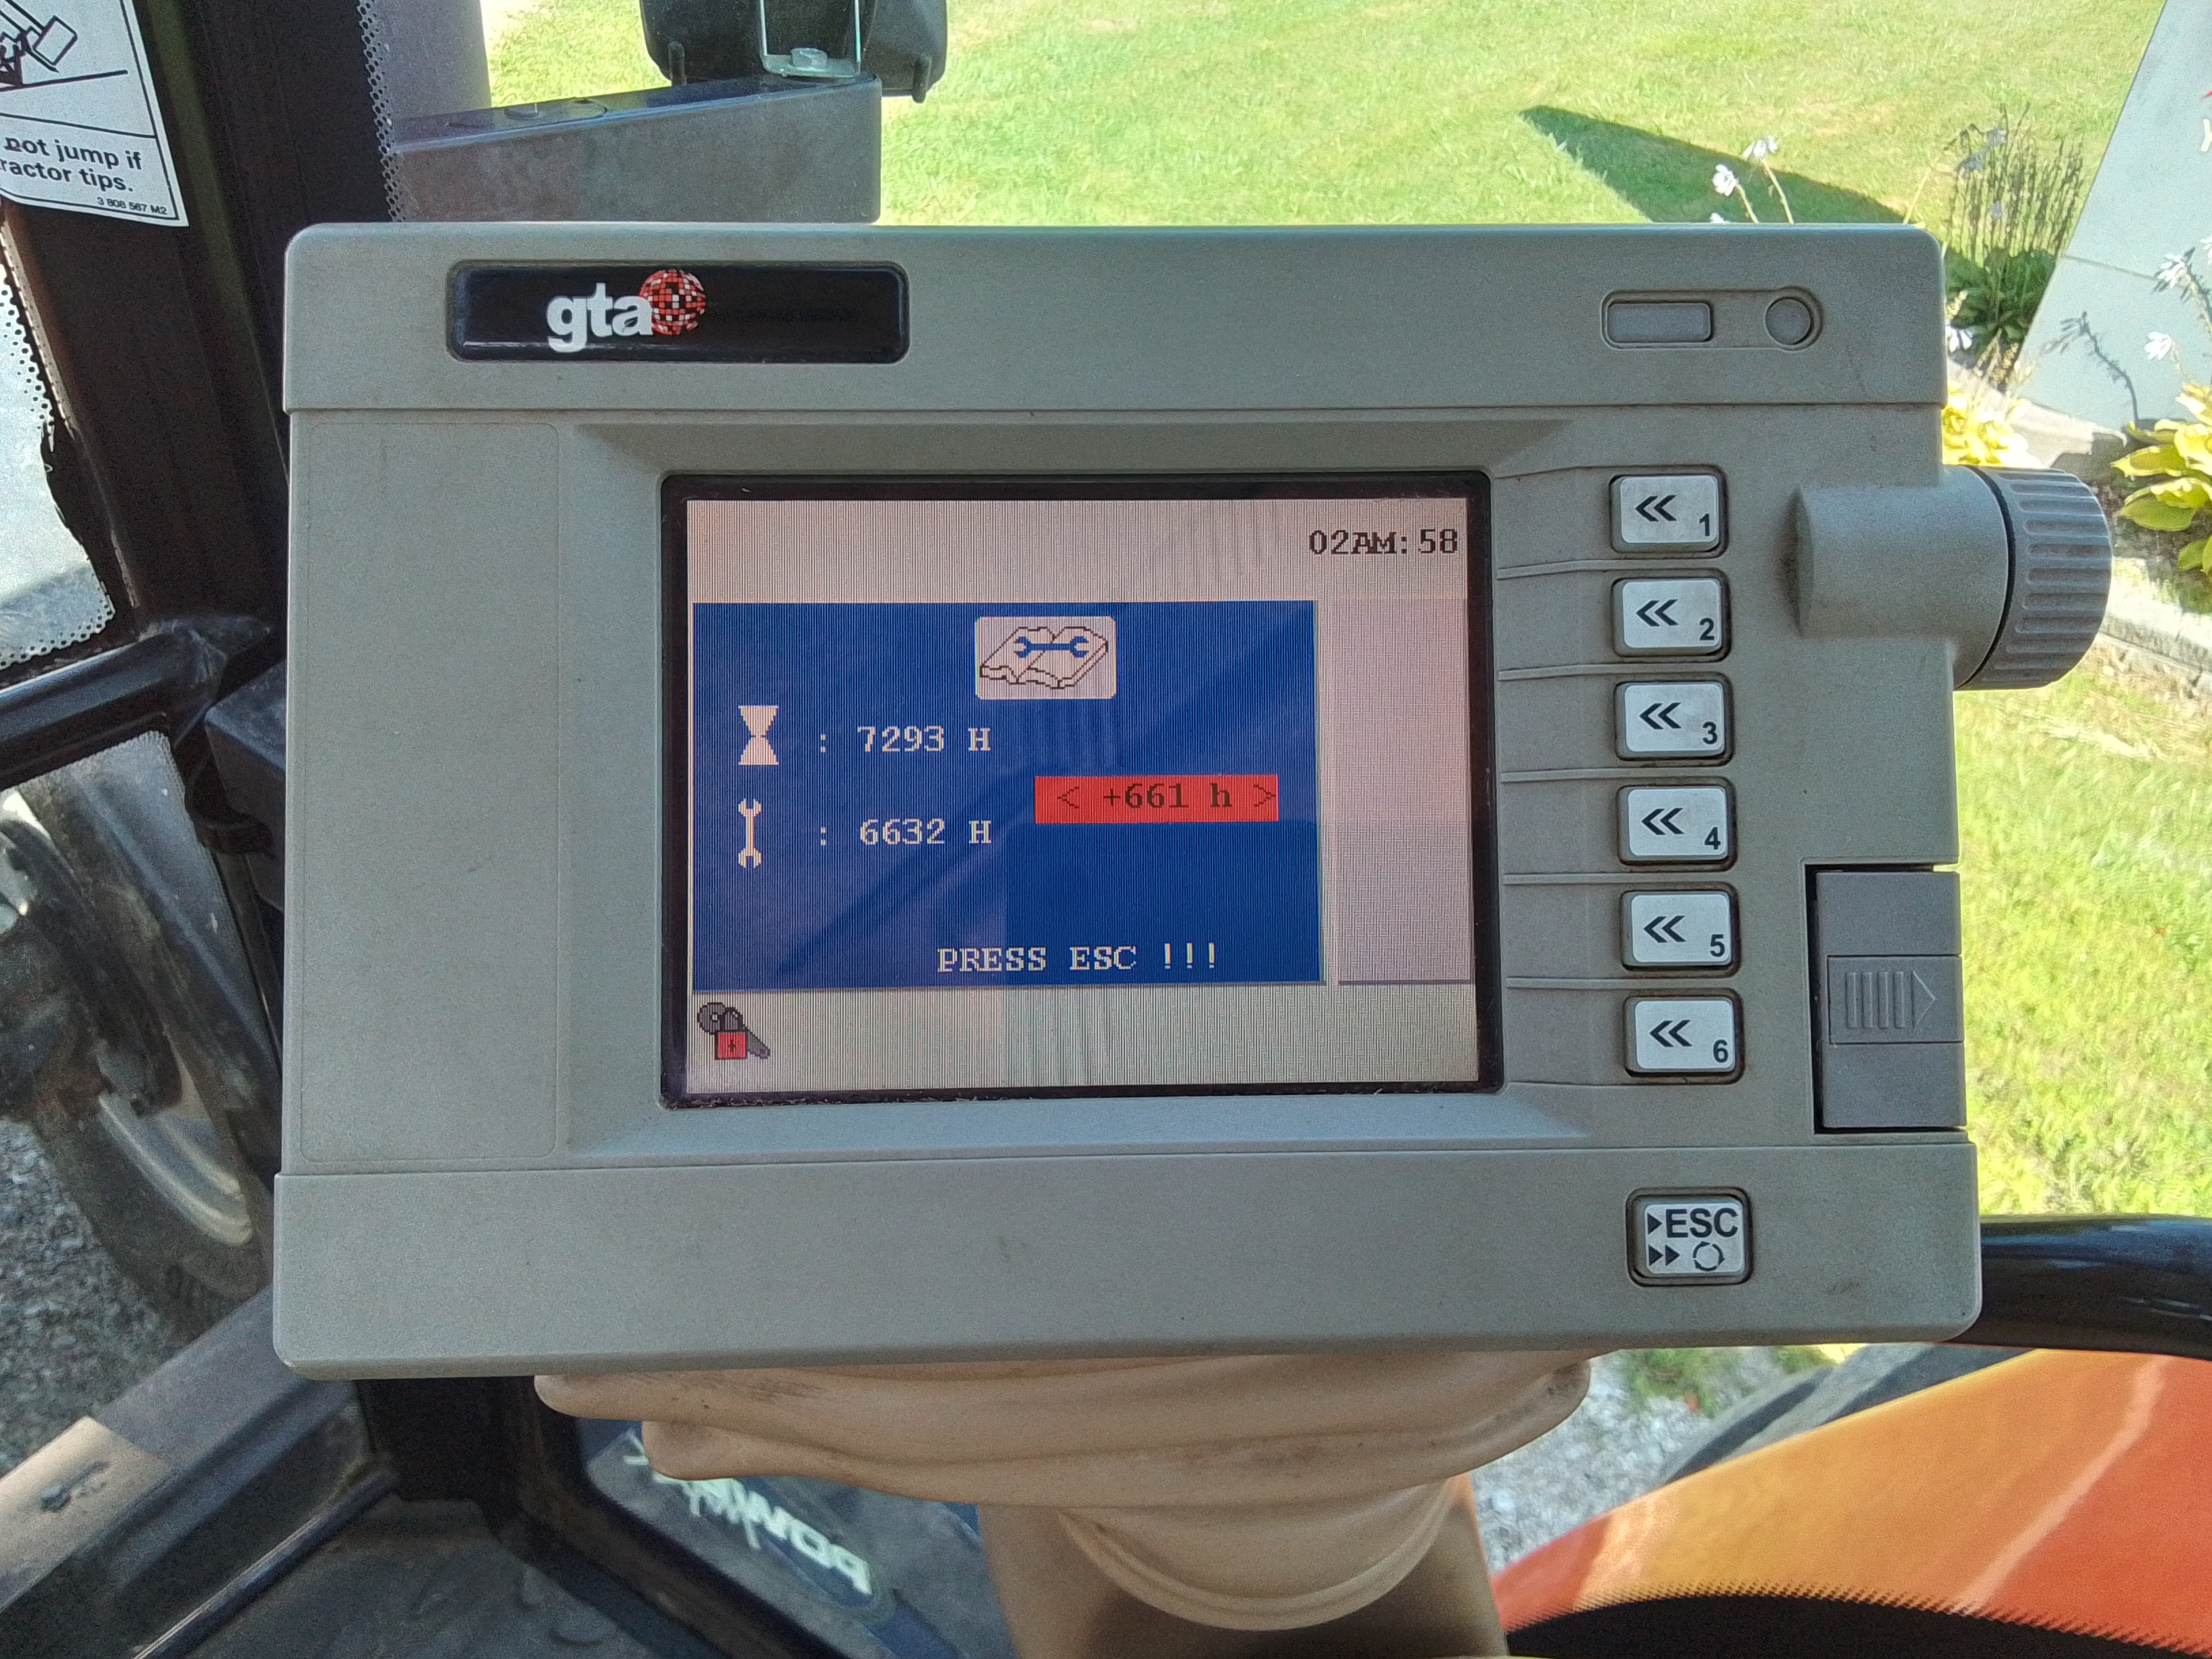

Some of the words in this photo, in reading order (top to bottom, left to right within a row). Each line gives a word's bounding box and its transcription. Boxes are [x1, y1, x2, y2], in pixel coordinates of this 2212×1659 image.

[54, 138, 120, 170] jump
[125, 150, 142, 170] if
[0, 158, 72, 183] ractor
[79, 167, 134, 192] tips.
[96, 197, 105, 205] 3
[150, 204, 168, 216] M2
[547, 283, 653, 352] gta
[1698, 513, 1711, 537] 1
[1699, 617, 1715, 641] 2
[857, 725, 944, 753] 7293
[967, 727, 991, 752] H
[1702, 721, 1719, 745] 3
[1103, 783, 1189, 809] +661
[1210, 782, 1233, 808] h
[859, 817, 945, 845] 6632
[968, 819, 992, 844] H
[1704, 827, 1721, 851] 4
[937, 945, 1047, 973] PRESS
[1069, 945, 1138, 970] ESC
[1709, 933, 1725, 958] 5
[1712, 1039, 1729, 1063] 6
[1665, 1207, 1739, 1239] ESC
